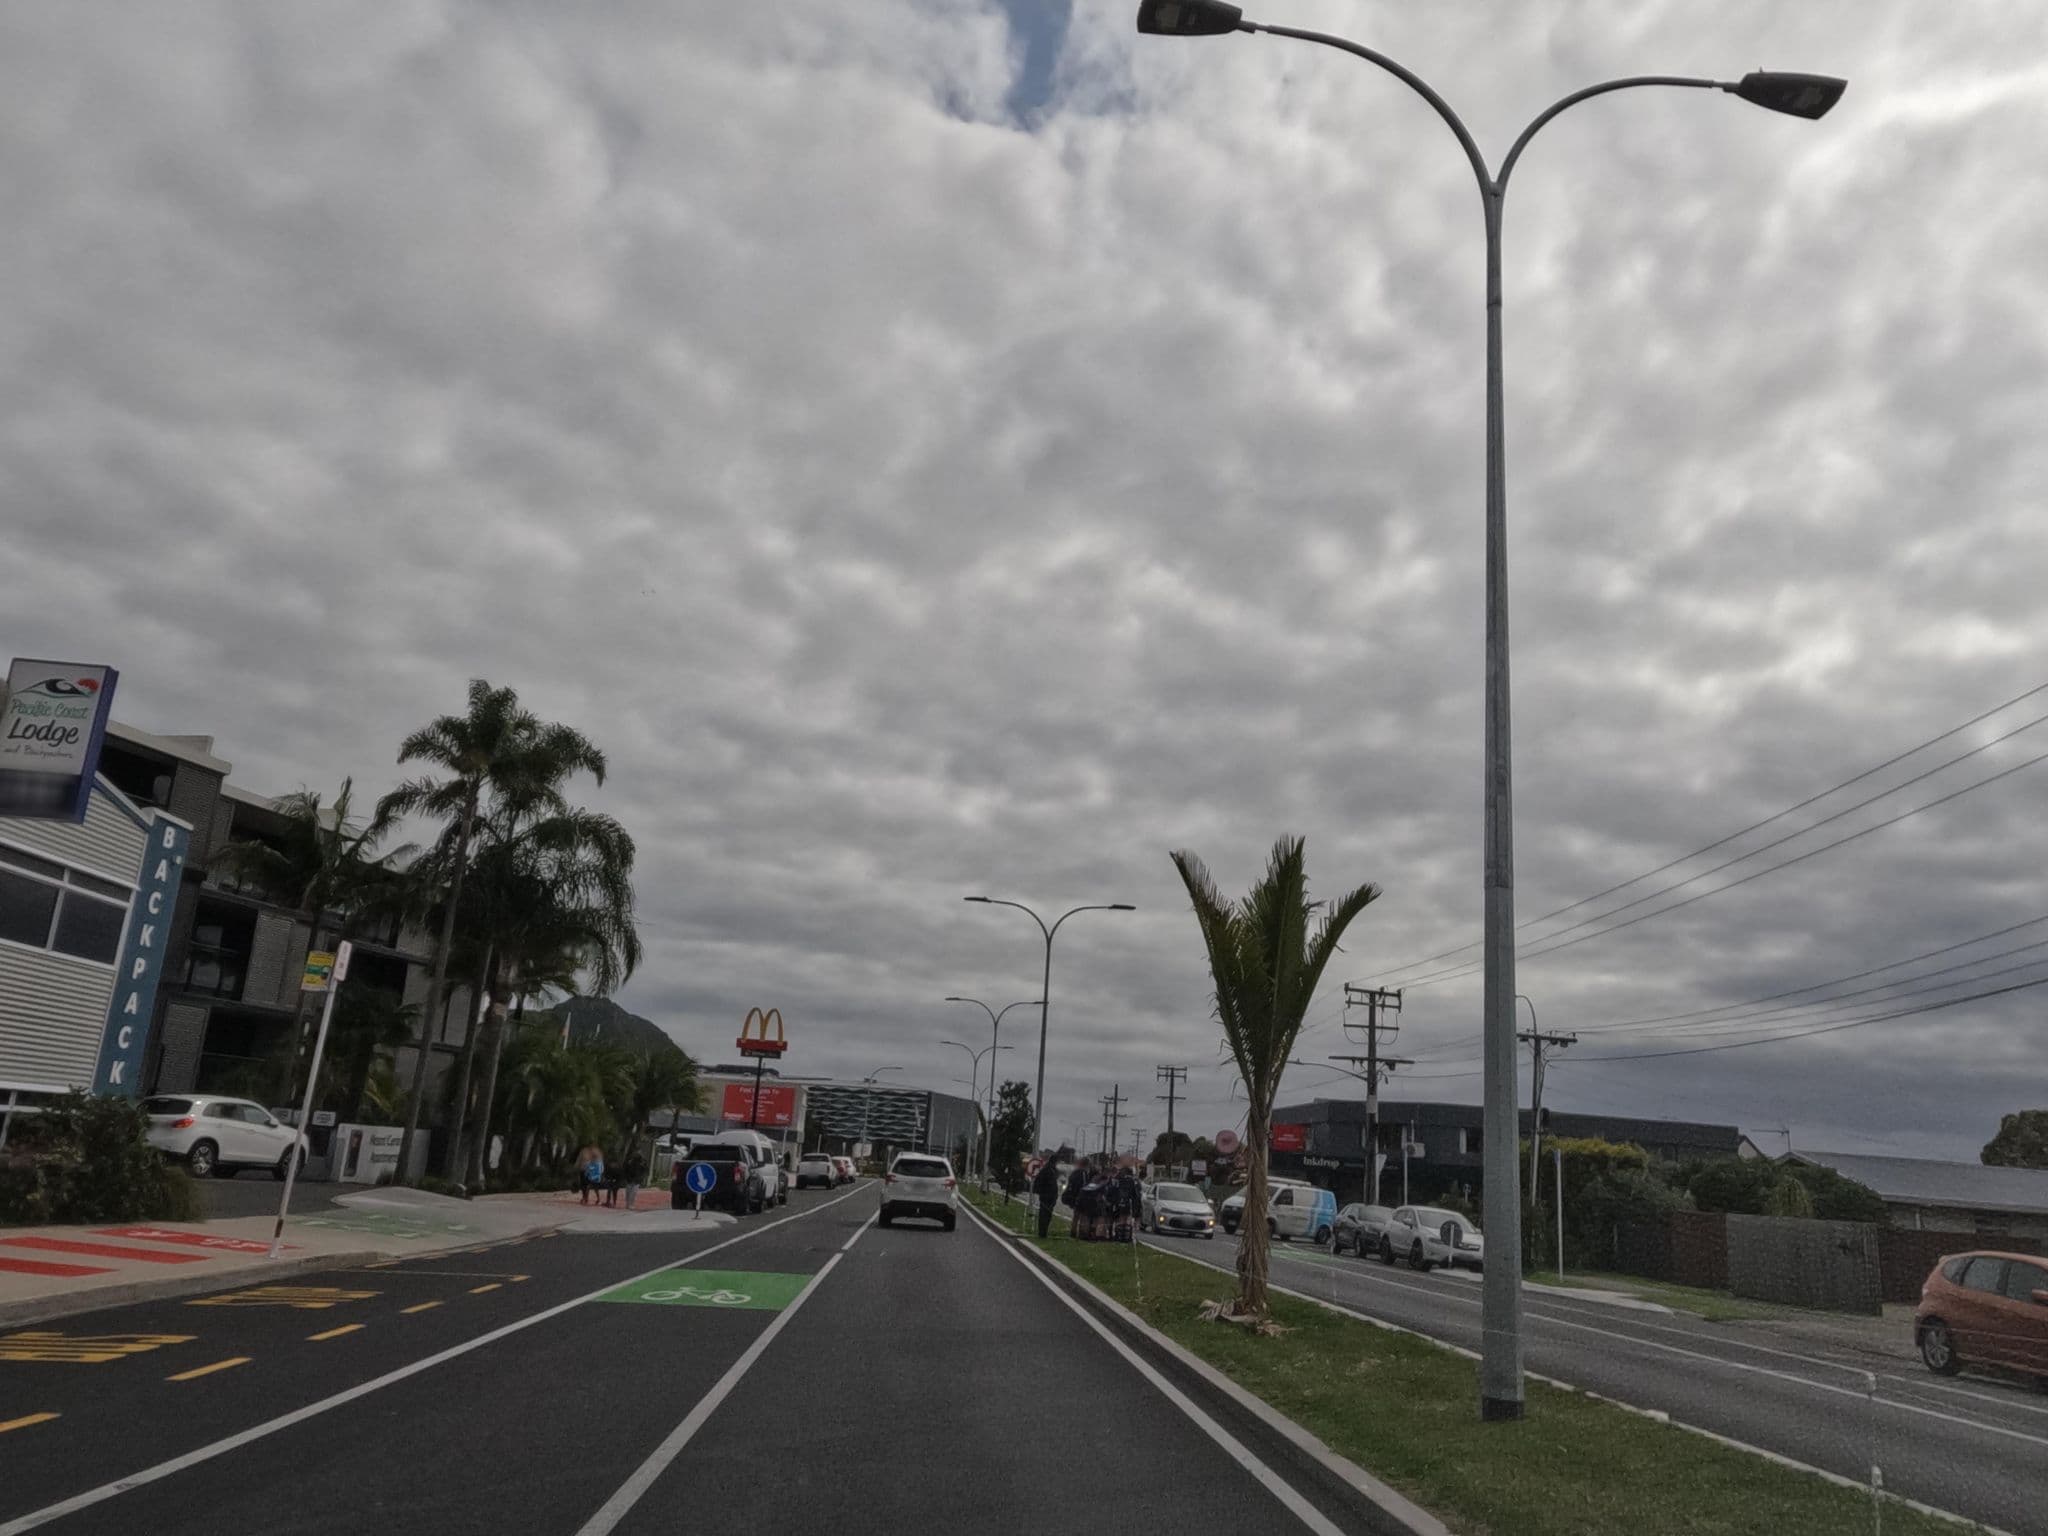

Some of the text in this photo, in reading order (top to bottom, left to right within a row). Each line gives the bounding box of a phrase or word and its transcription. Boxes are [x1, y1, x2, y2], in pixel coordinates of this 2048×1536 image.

[9, 698, 89, 718] Pacific Coast
[7, 718, 79, 747] Lodge
[1303, 1156, 1340, 1170] Inkdrop
